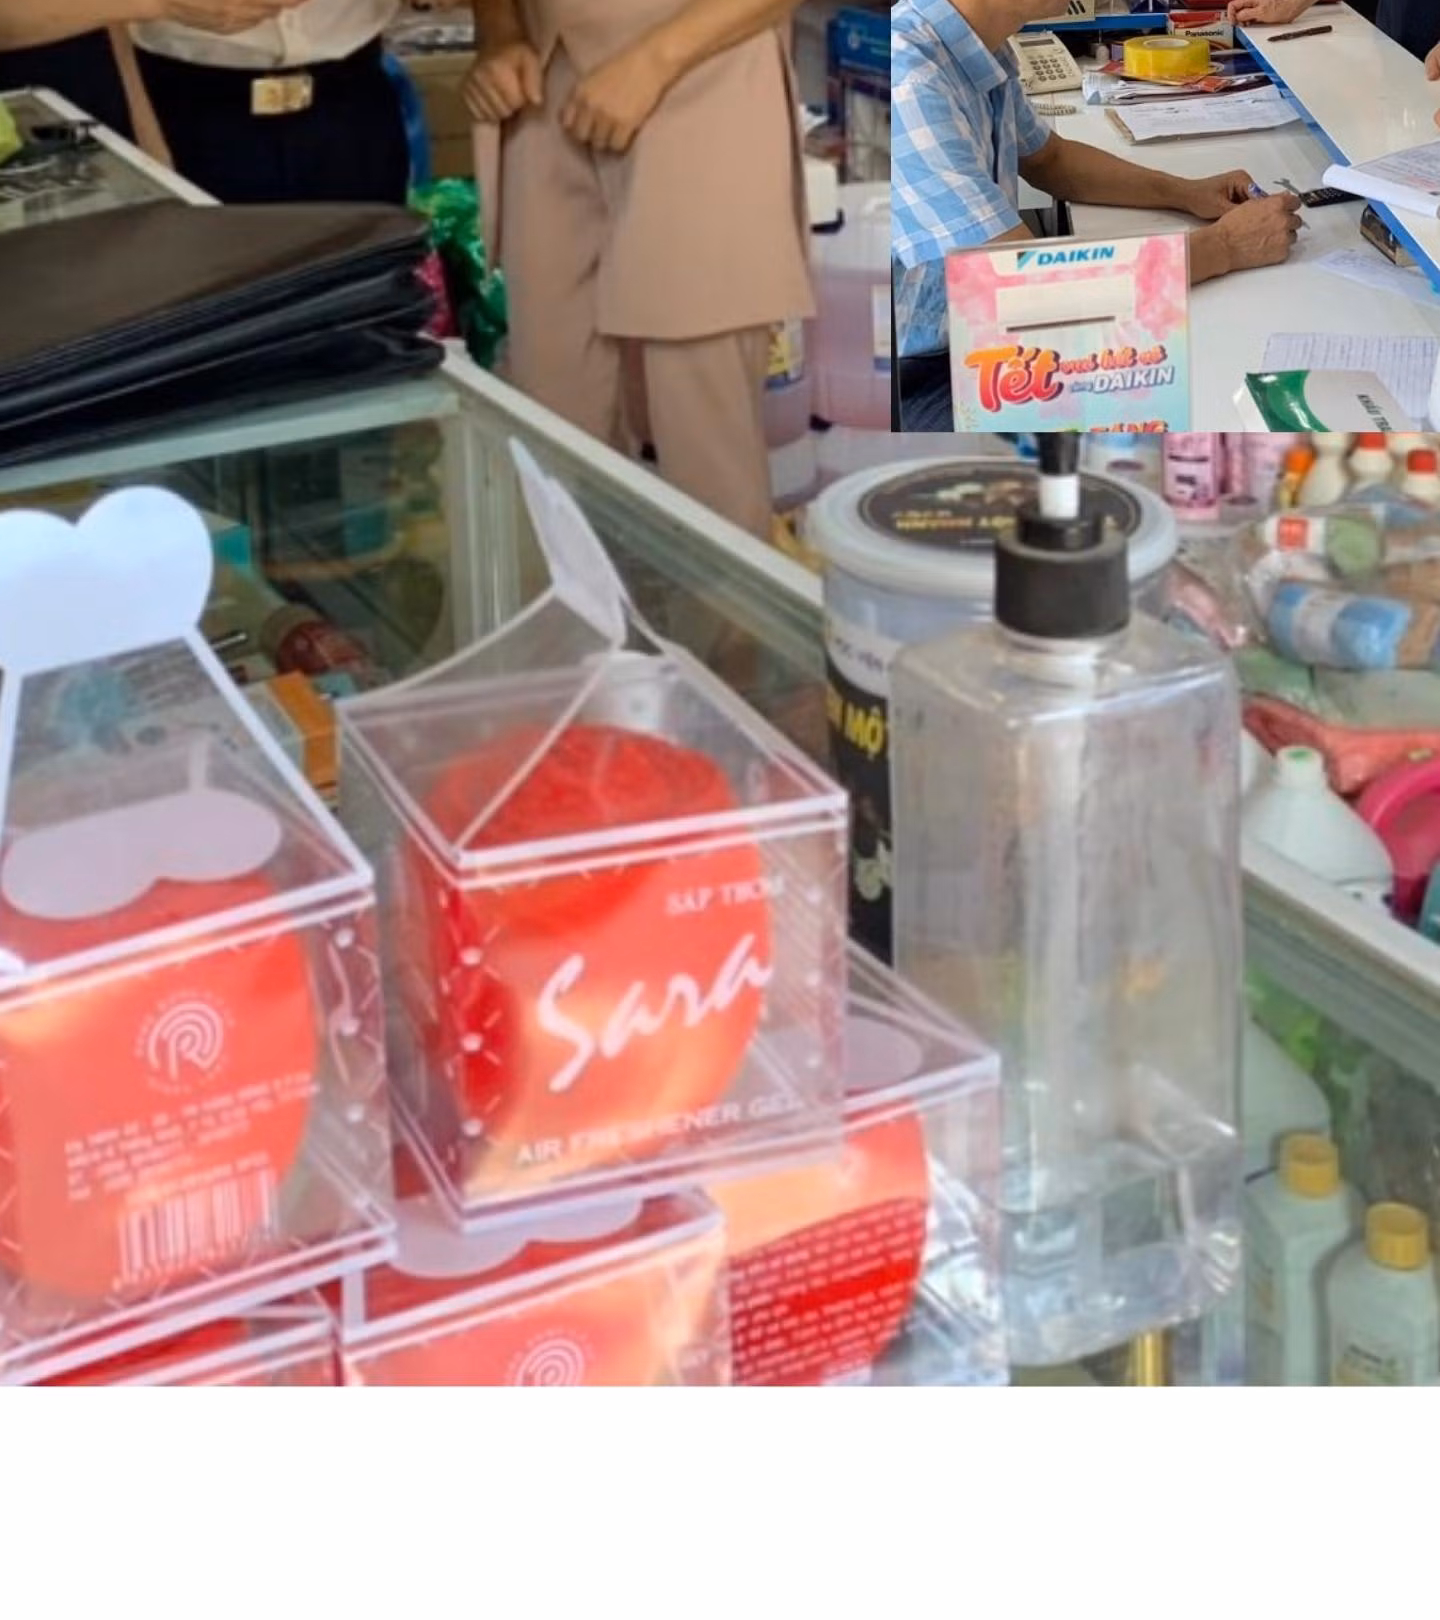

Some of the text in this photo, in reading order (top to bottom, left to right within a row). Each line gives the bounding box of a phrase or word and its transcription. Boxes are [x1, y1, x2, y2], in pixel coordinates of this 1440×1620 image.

[1184, 29, 1225, 38] Panasonic
[1037, 246, 1115, 266] DAIKIN
[964, 345, 1064, 412] Tết
[1093, 366, 1175, 394] DAIKIN
[536, 933, 773, 1093] Sara
[517, 1137, 561, 1166] AIR
